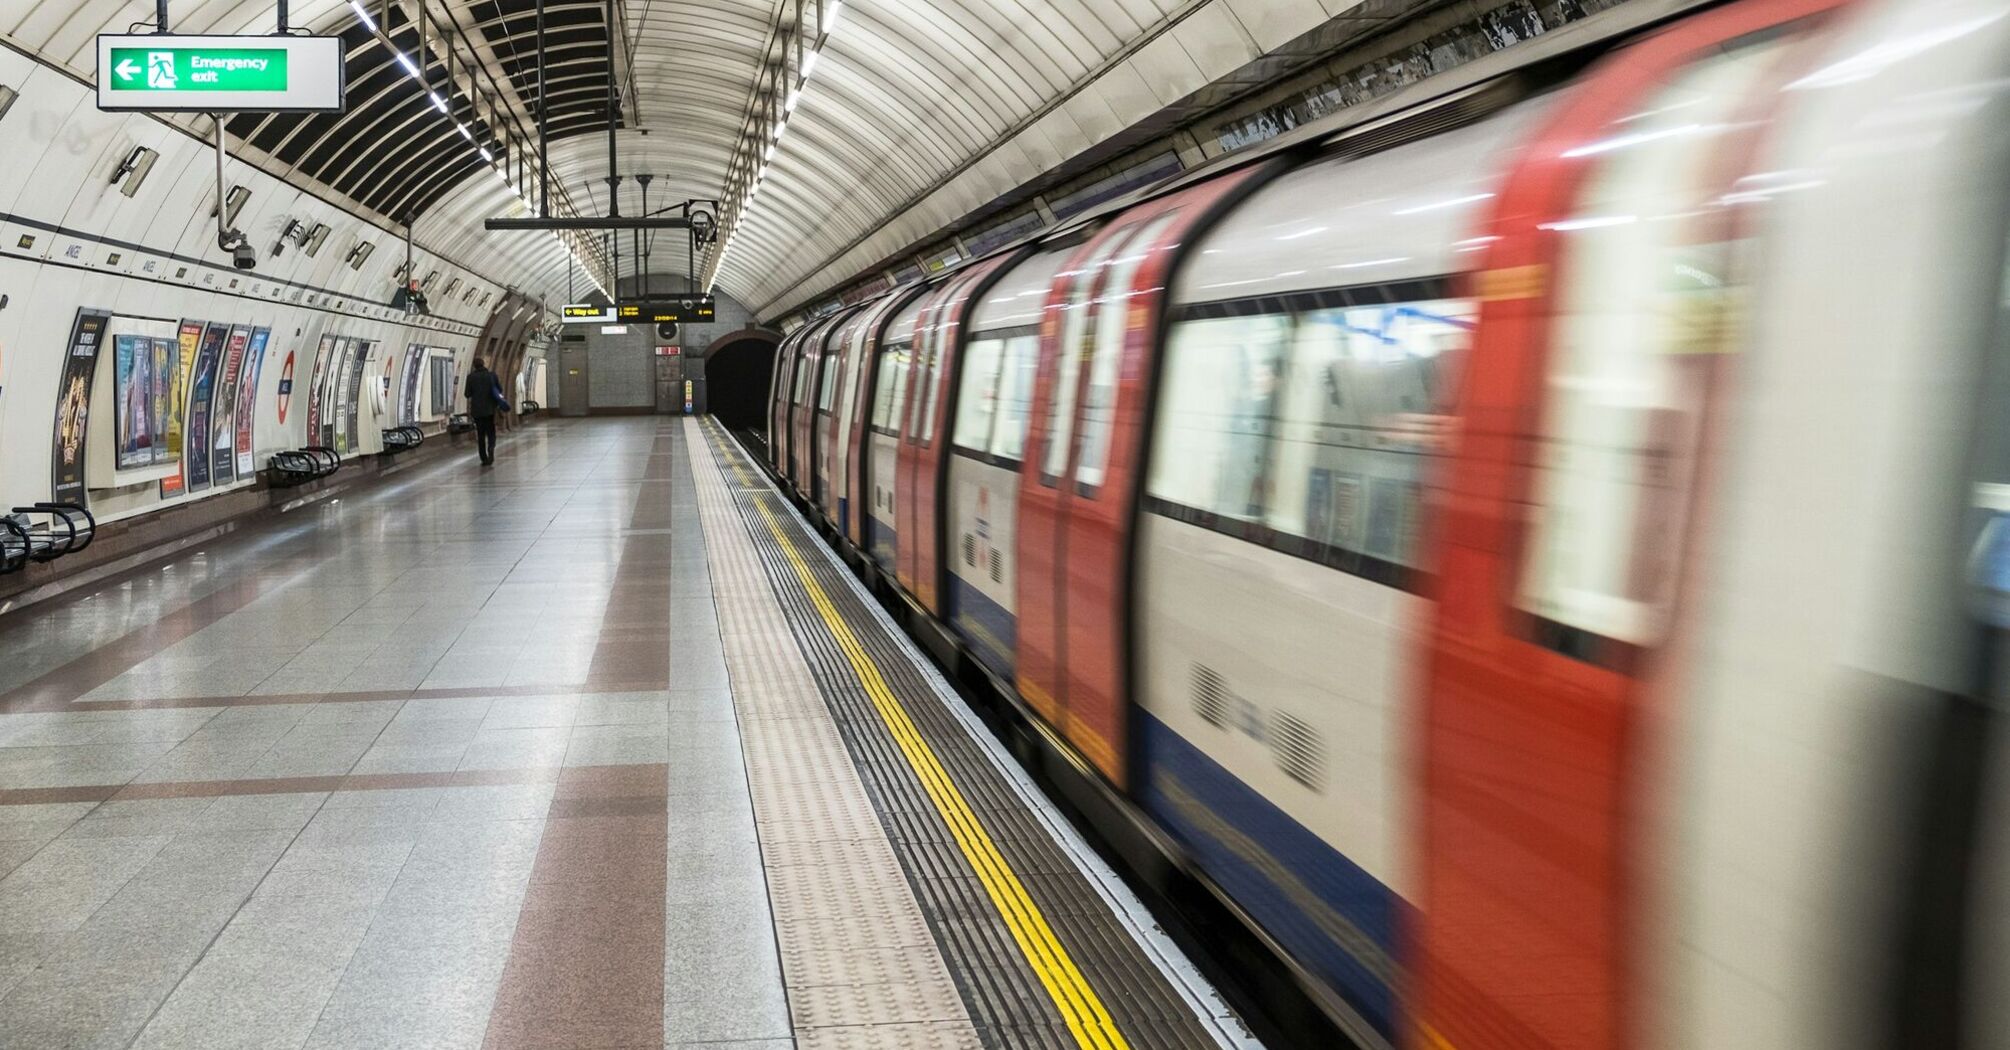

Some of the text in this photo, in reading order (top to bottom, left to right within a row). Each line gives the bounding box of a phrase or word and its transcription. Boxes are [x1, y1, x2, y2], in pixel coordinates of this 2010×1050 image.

[191, 55, 269, 72] Emergency
[191, 70, 219, 82] exit
[572, 308, 600, 317] Way out
